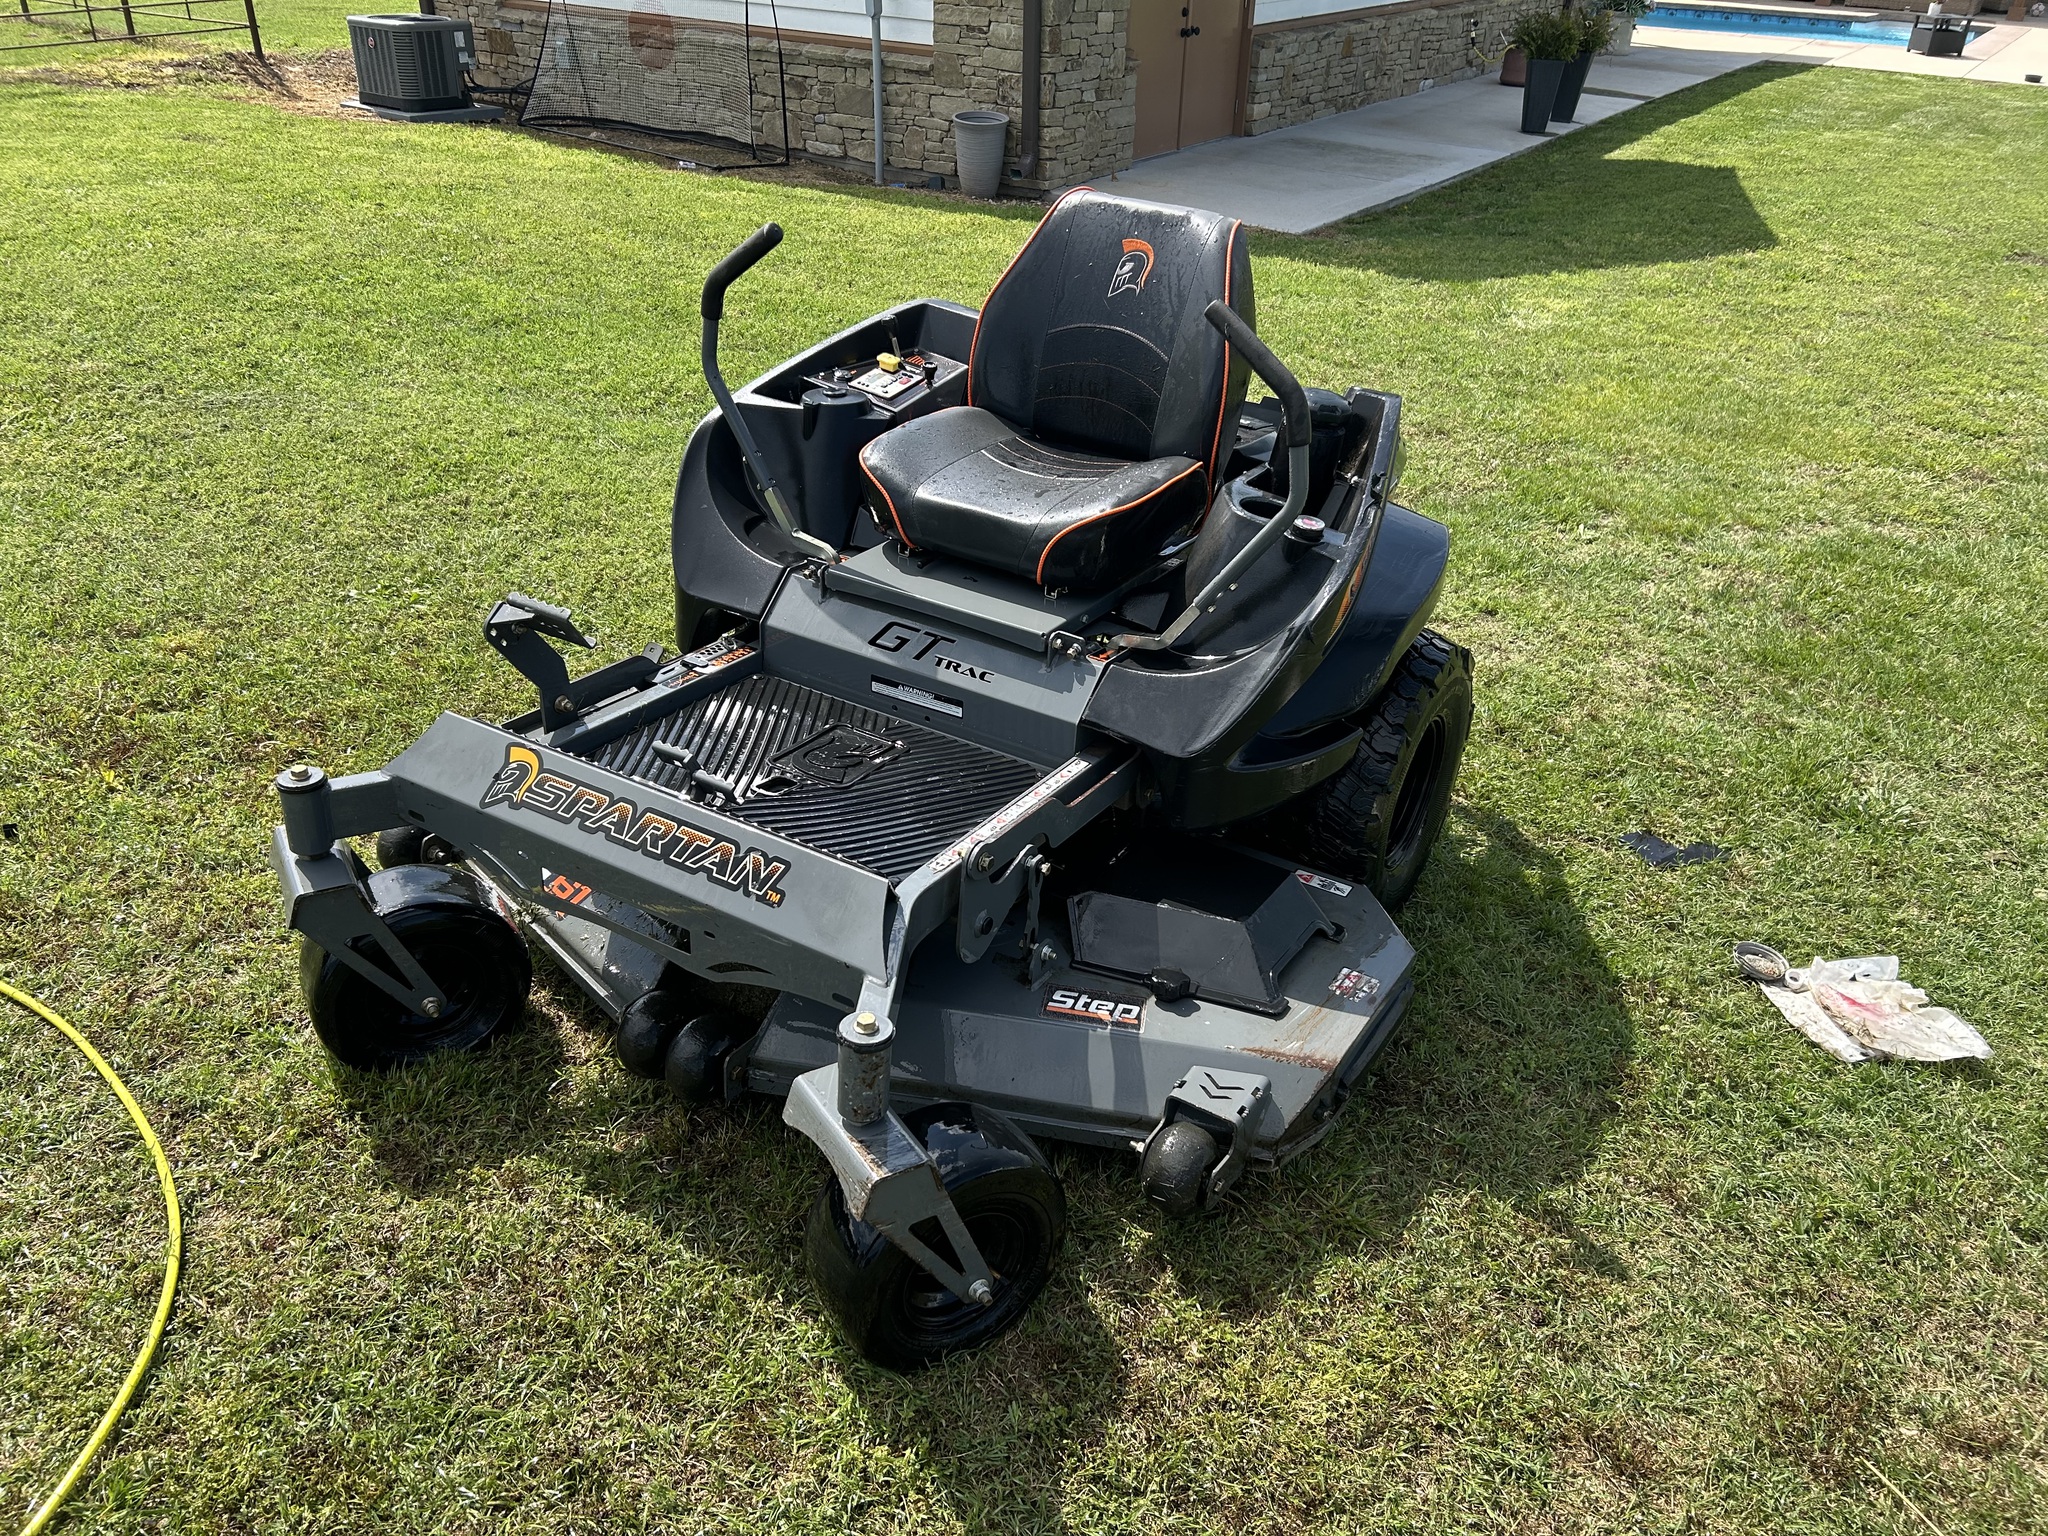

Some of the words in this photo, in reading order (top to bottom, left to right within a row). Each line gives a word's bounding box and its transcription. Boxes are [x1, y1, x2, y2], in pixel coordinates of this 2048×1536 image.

[867, 621, 957, 661] GT
[935, 655, 995, 684] TRAC
[903, 685, 935, 699] WARNING!
[522, 774, 786, 895] SPARTAN
[1047, 989, 1141, 1022] Step
